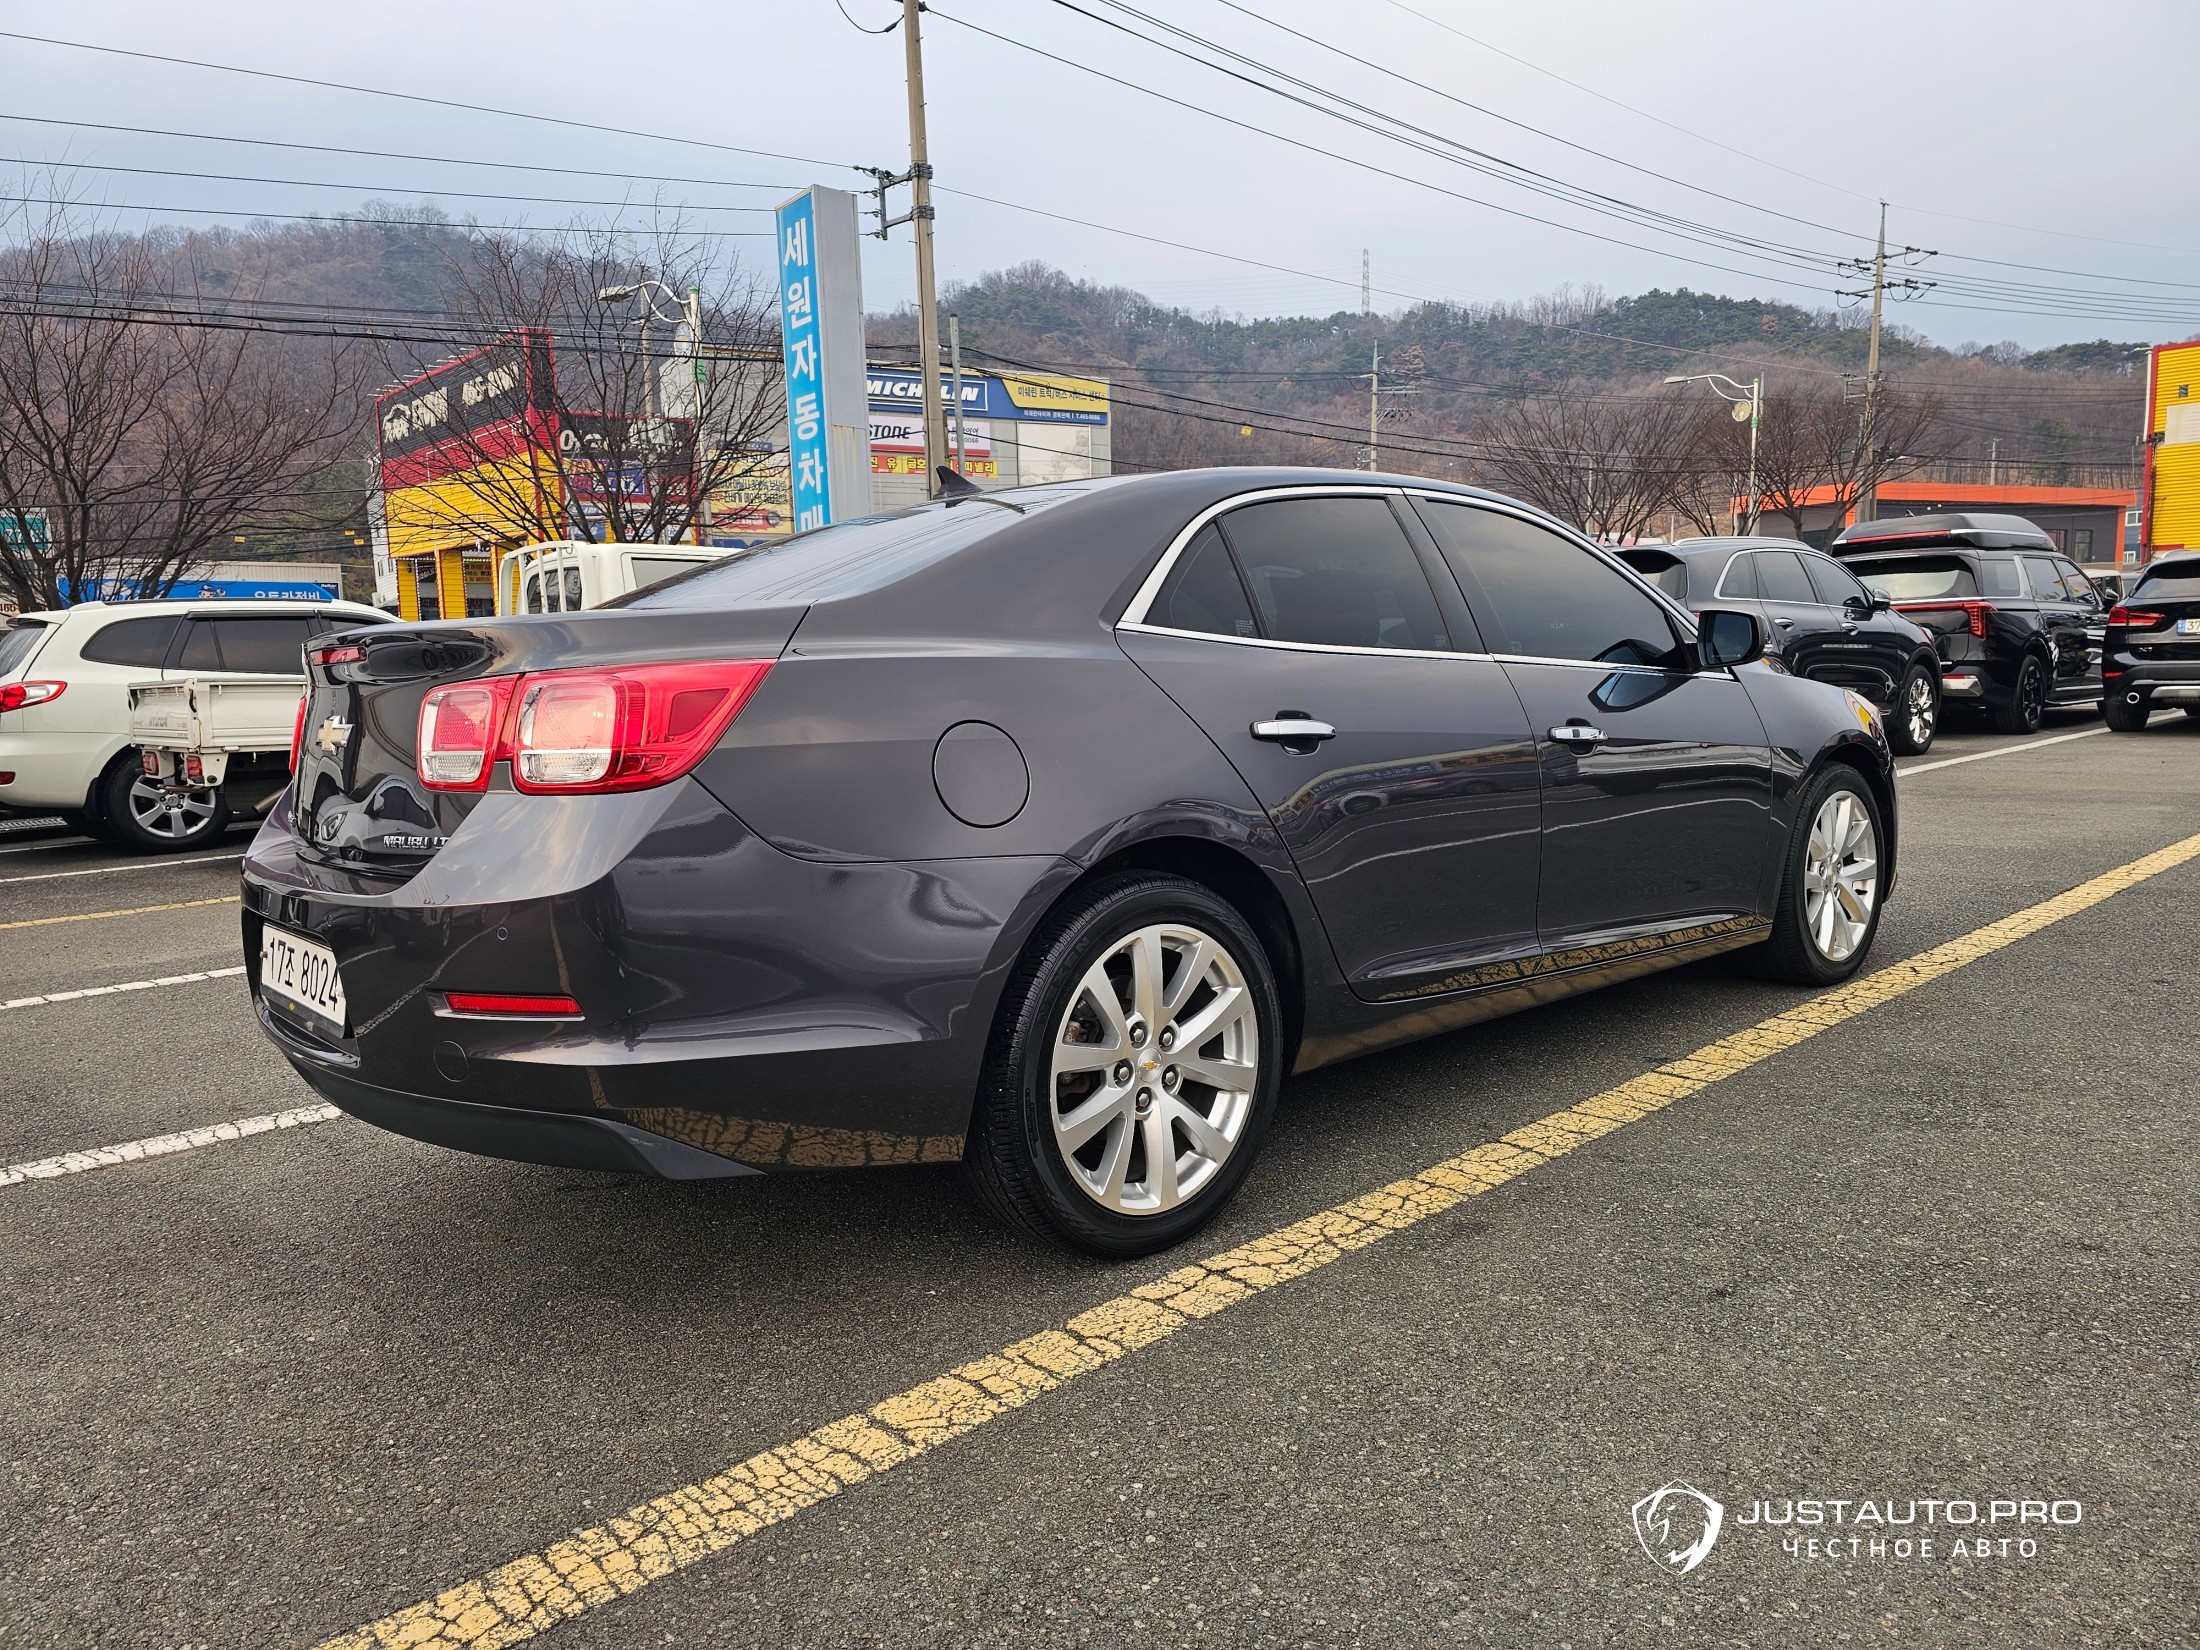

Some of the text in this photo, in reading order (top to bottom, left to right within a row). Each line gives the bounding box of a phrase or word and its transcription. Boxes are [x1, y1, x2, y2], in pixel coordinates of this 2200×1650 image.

[867, 380, 979, 401] MICHLN
[383, 835, 429, 849] MALIBU
[270, 937, 338, 1012] 17조 8024
